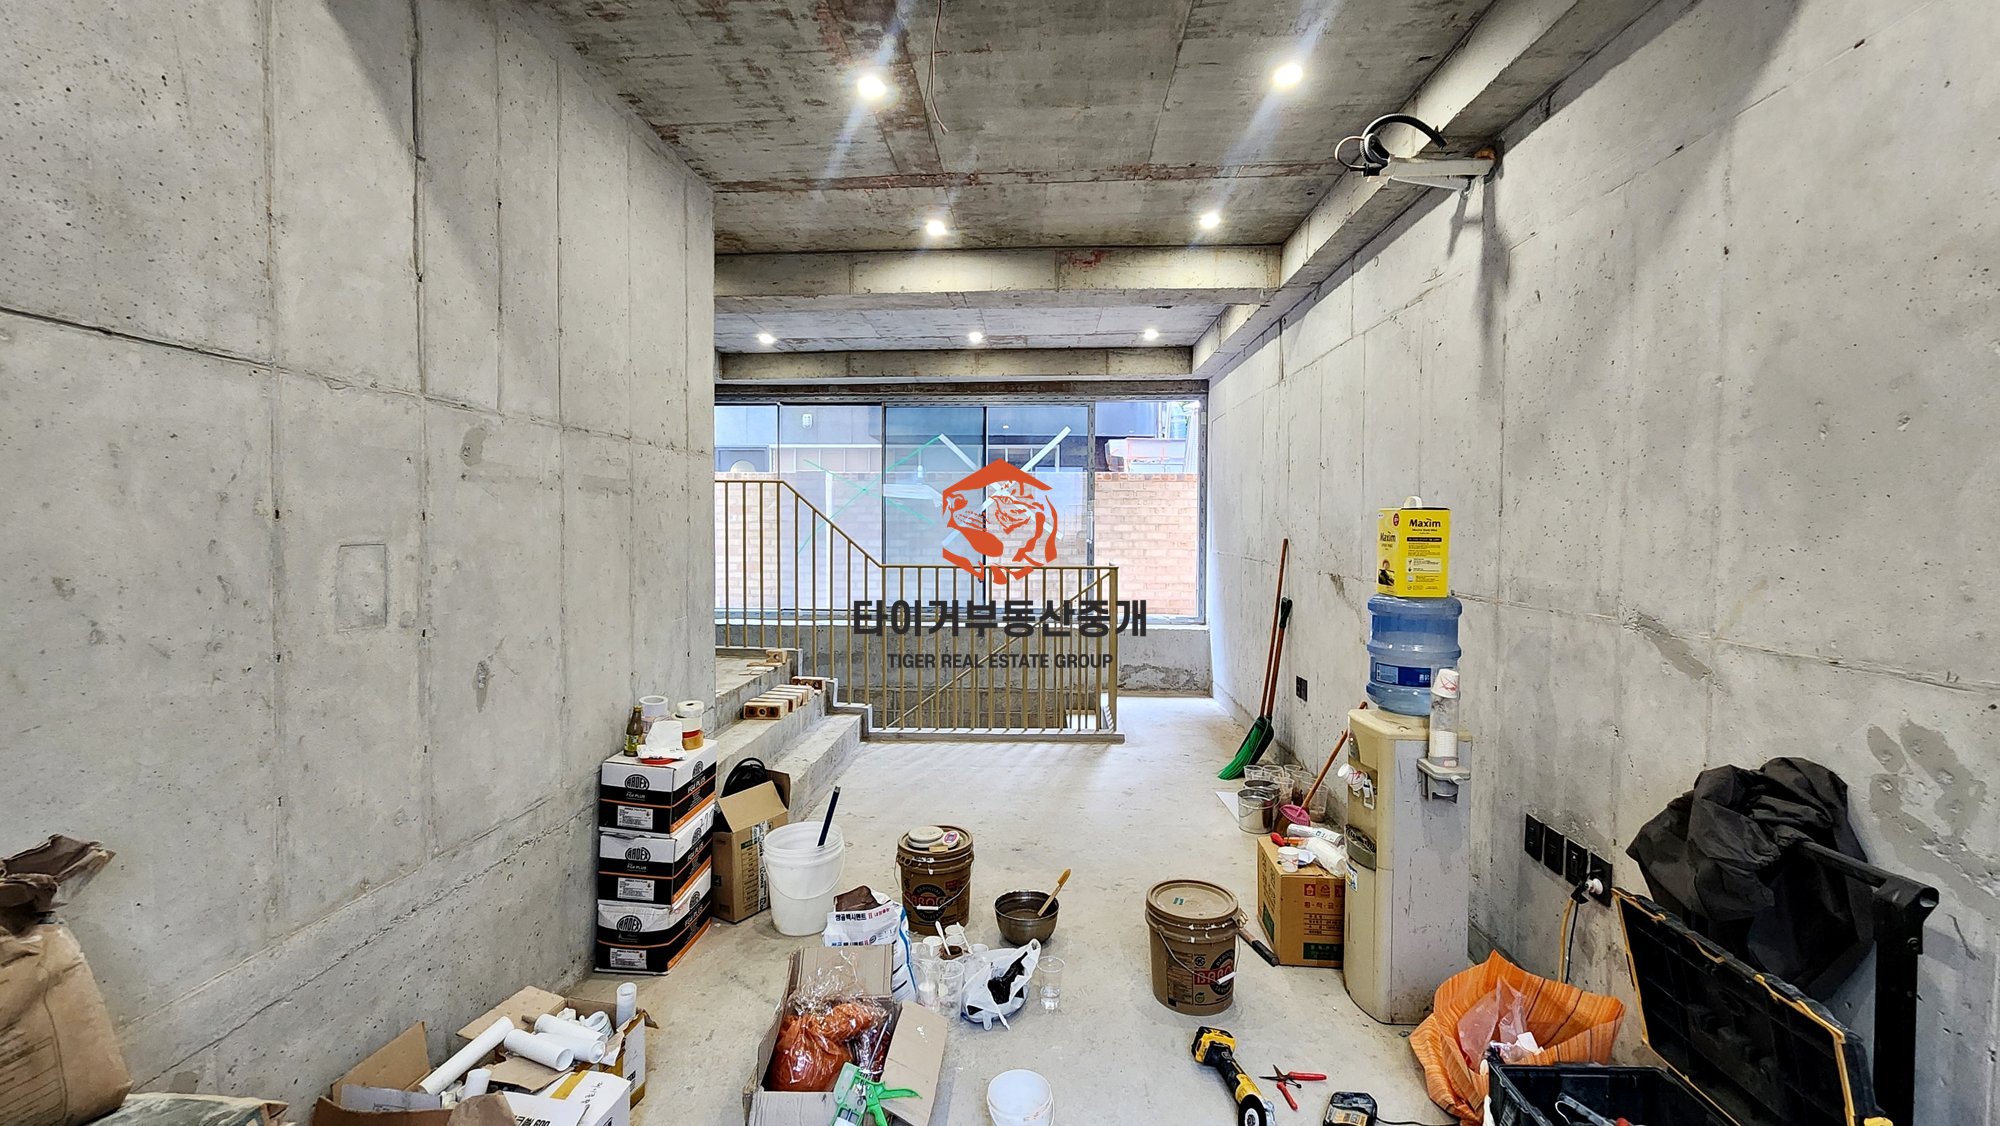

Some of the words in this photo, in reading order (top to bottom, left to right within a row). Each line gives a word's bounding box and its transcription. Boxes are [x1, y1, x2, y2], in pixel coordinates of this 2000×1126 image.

[1409, 518, 1441, 529] Maxim
[1380, 531, 1396, 542] Maxim
[626, 775, 649, 790] ARDEX
[626, 847, 650, 861] ARDEX
[618, 916, 642, 932] ARDEX
